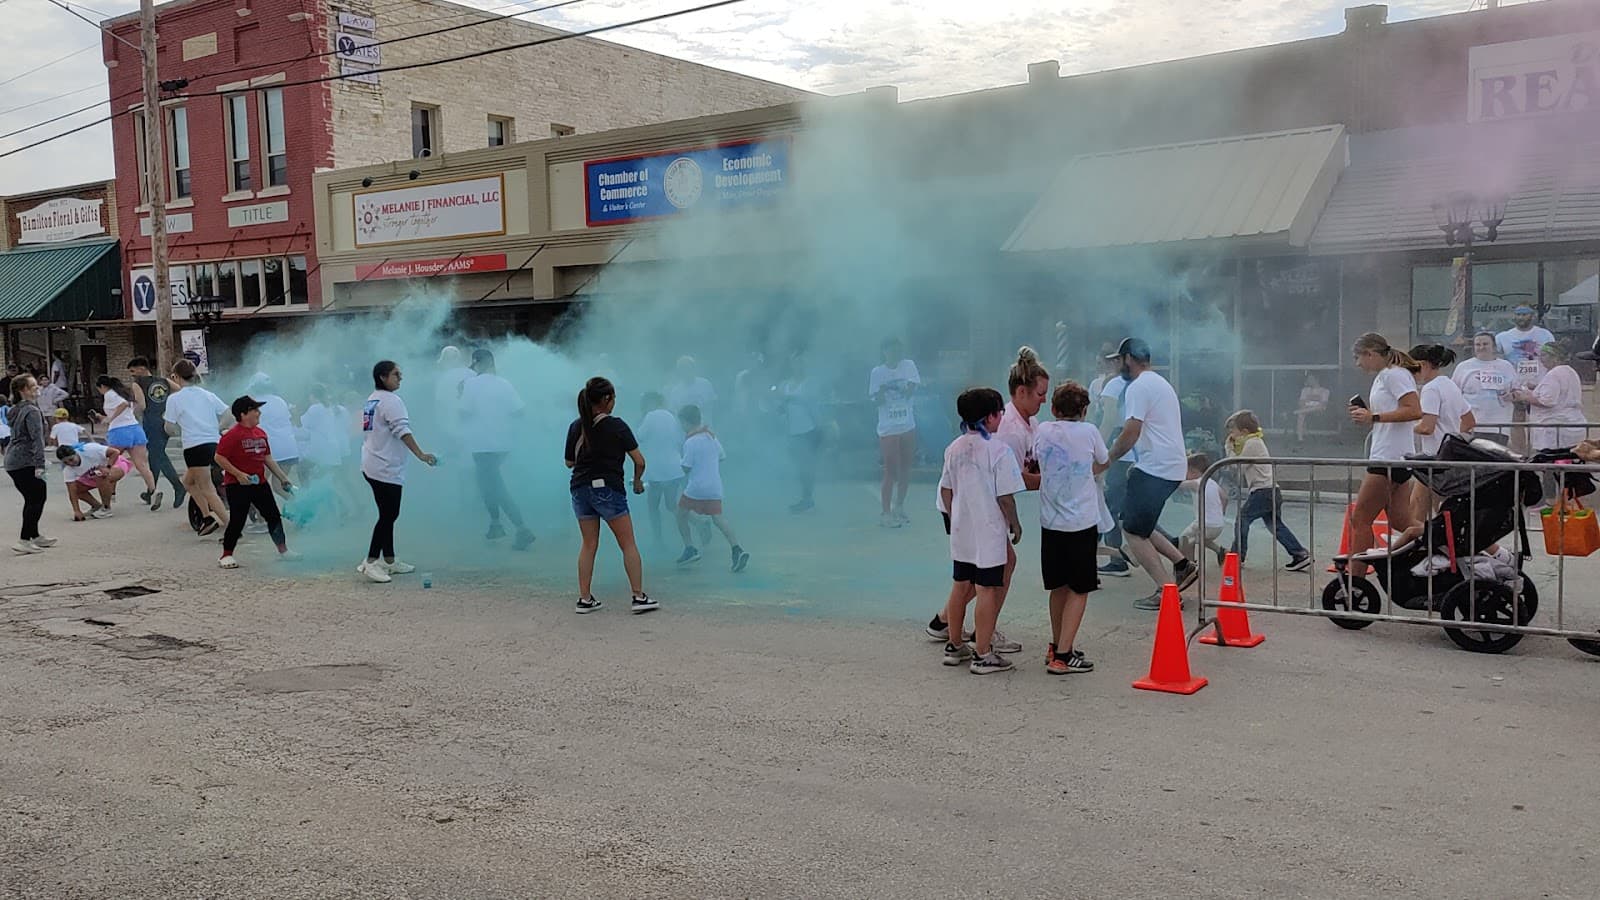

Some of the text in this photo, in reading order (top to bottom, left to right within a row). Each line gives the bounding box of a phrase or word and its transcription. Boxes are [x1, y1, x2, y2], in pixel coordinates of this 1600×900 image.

[346, 17, 369, 27] LAW
[722, 152, 772, 171] Economic
[598, 168, 649, 187] Chamber of
[714, 169, 783, 188] Development
[600, 184, 648, 201] Commerce
[381, 191, 500, 215] MELANIE J FINANCIAL, LLC
[22, 205, 98, 231] Hamilton Floral & Gifts
[242, 206, 273, 223] TITLE
[382, 266, 407, 275] Melanie
[407, 265, 414, 276] J.
[1471, 301, 1507, 313] vidson
